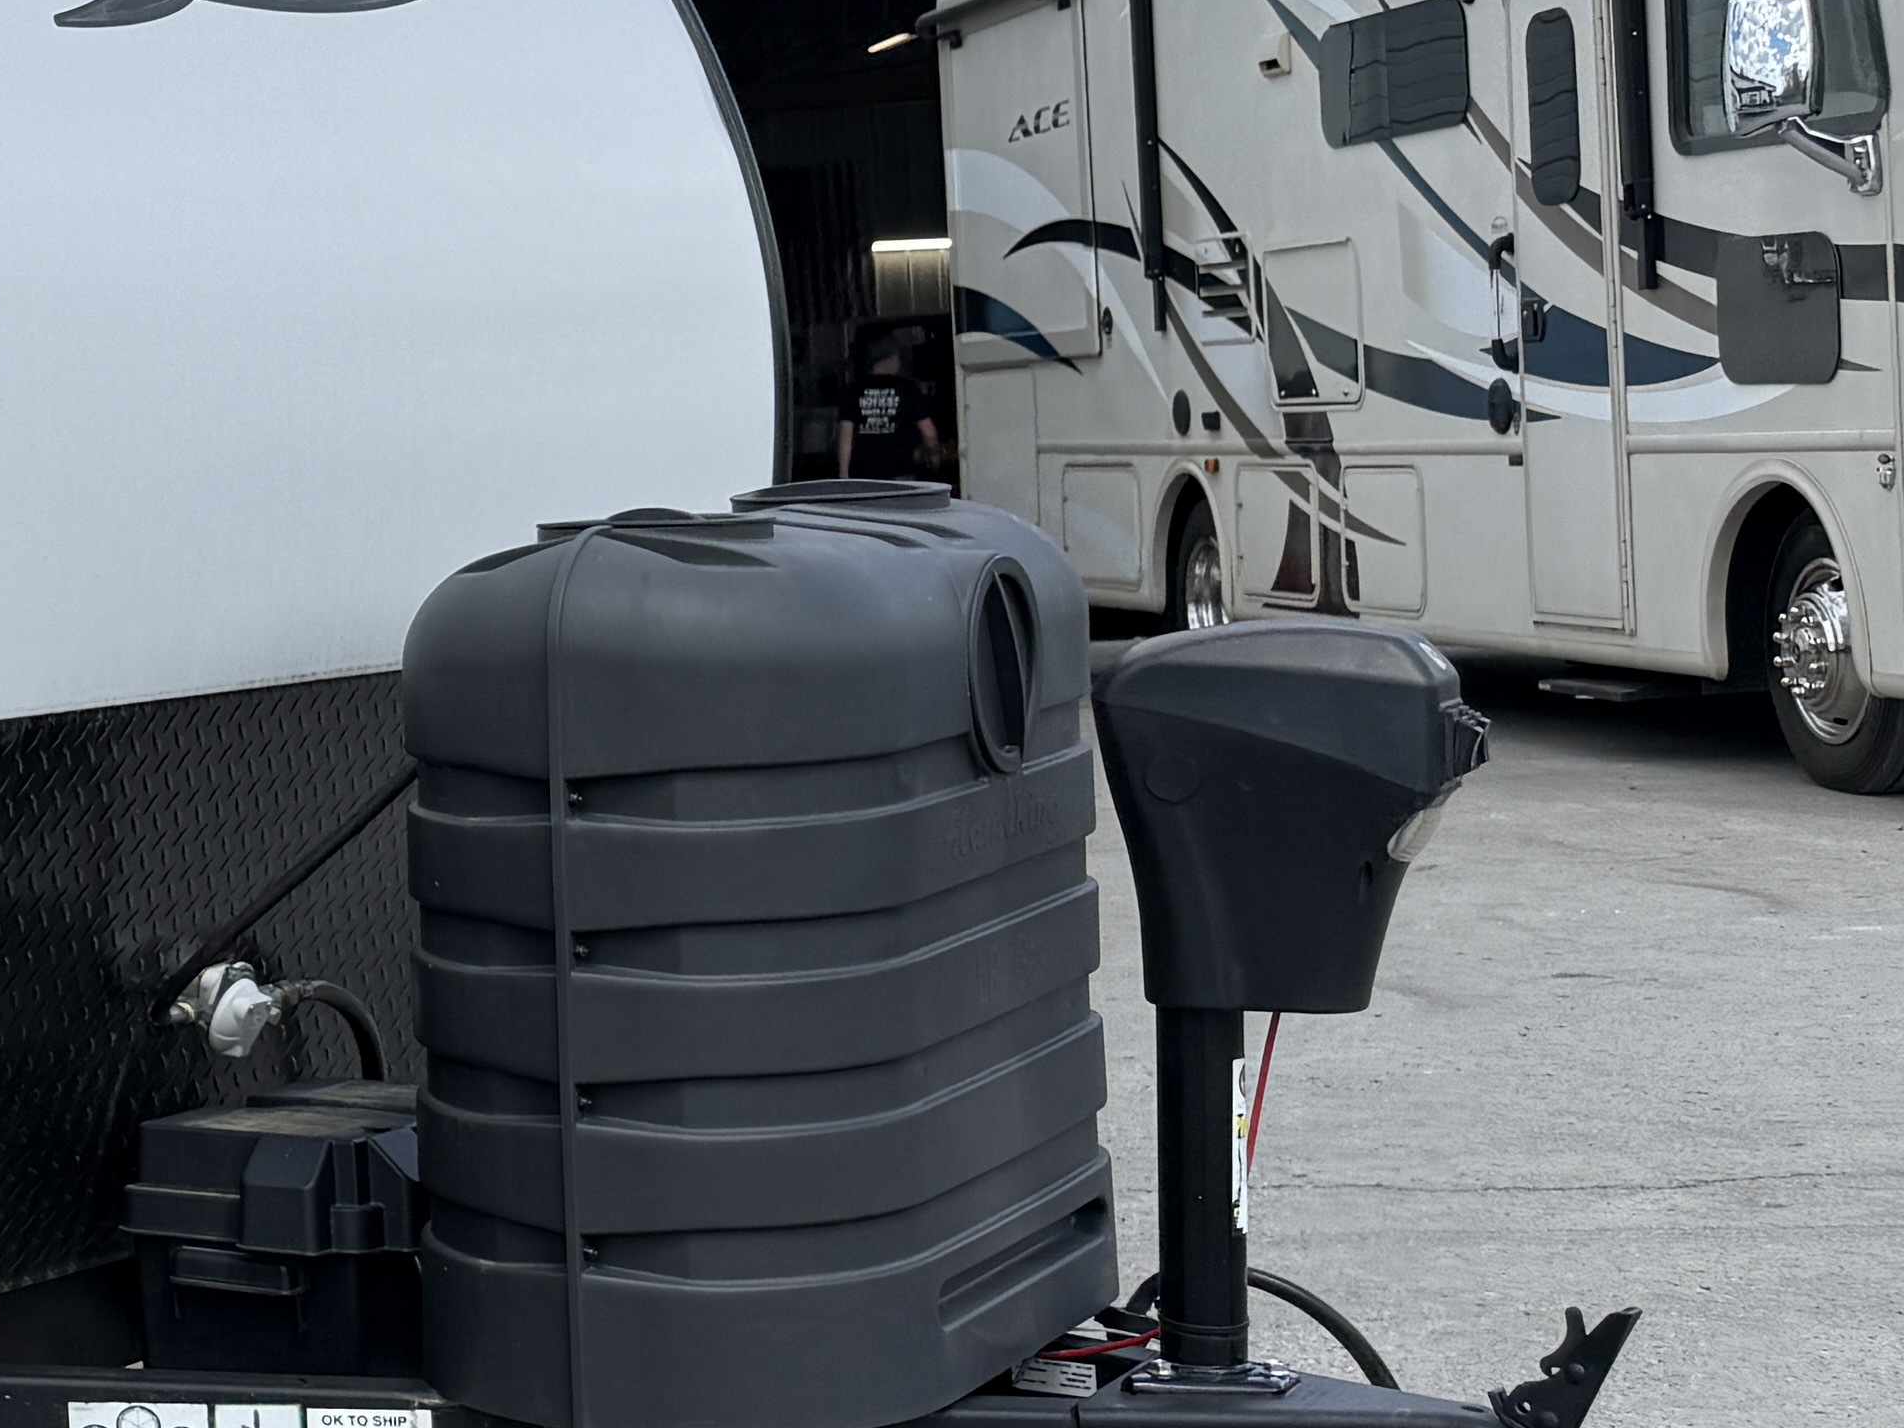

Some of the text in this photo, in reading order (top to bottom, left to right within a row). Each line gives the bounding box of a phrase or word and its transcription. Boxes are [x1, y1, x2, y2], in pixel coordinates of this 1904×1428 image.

[1008, 98, 1071, 143] ACE
[321, 1414, 408, 1428] OK TO SHIP
